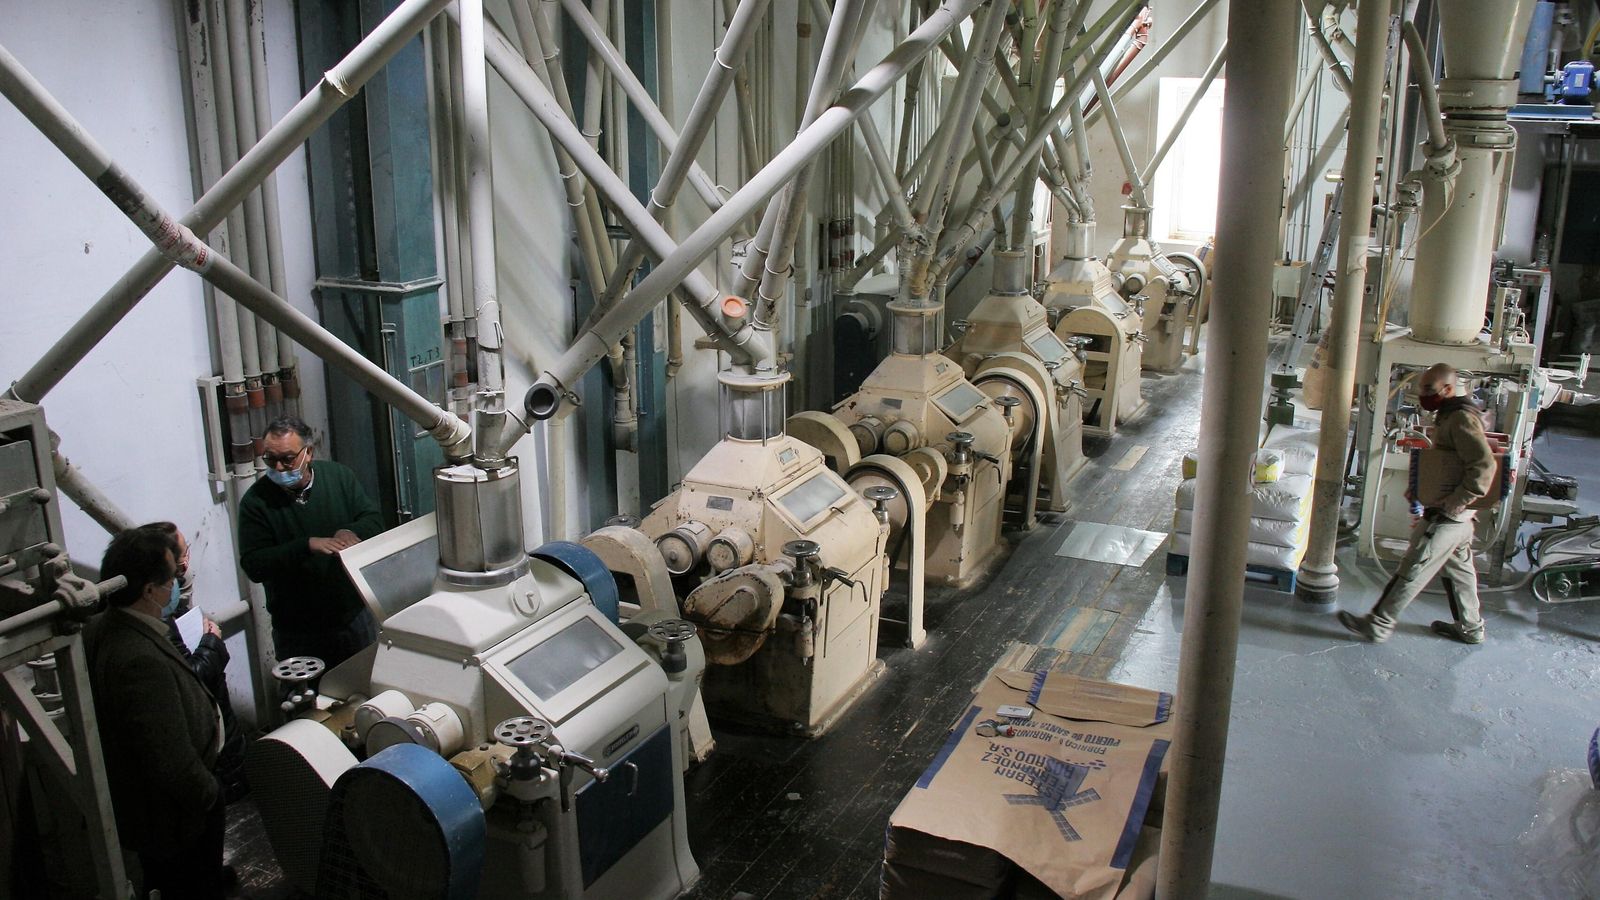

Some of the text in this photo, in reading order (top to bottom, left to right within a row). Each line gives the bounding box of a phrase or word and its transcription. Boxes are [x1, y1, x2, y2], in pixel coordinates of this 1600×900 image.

[1040, 721, 1070, 737] SANTA
[1084, 733, 1121, 747] PUERTO
[981, 751, 1069, 793] FERNANDEZ
[993, 766, 1063, 802] ESTEBAN
